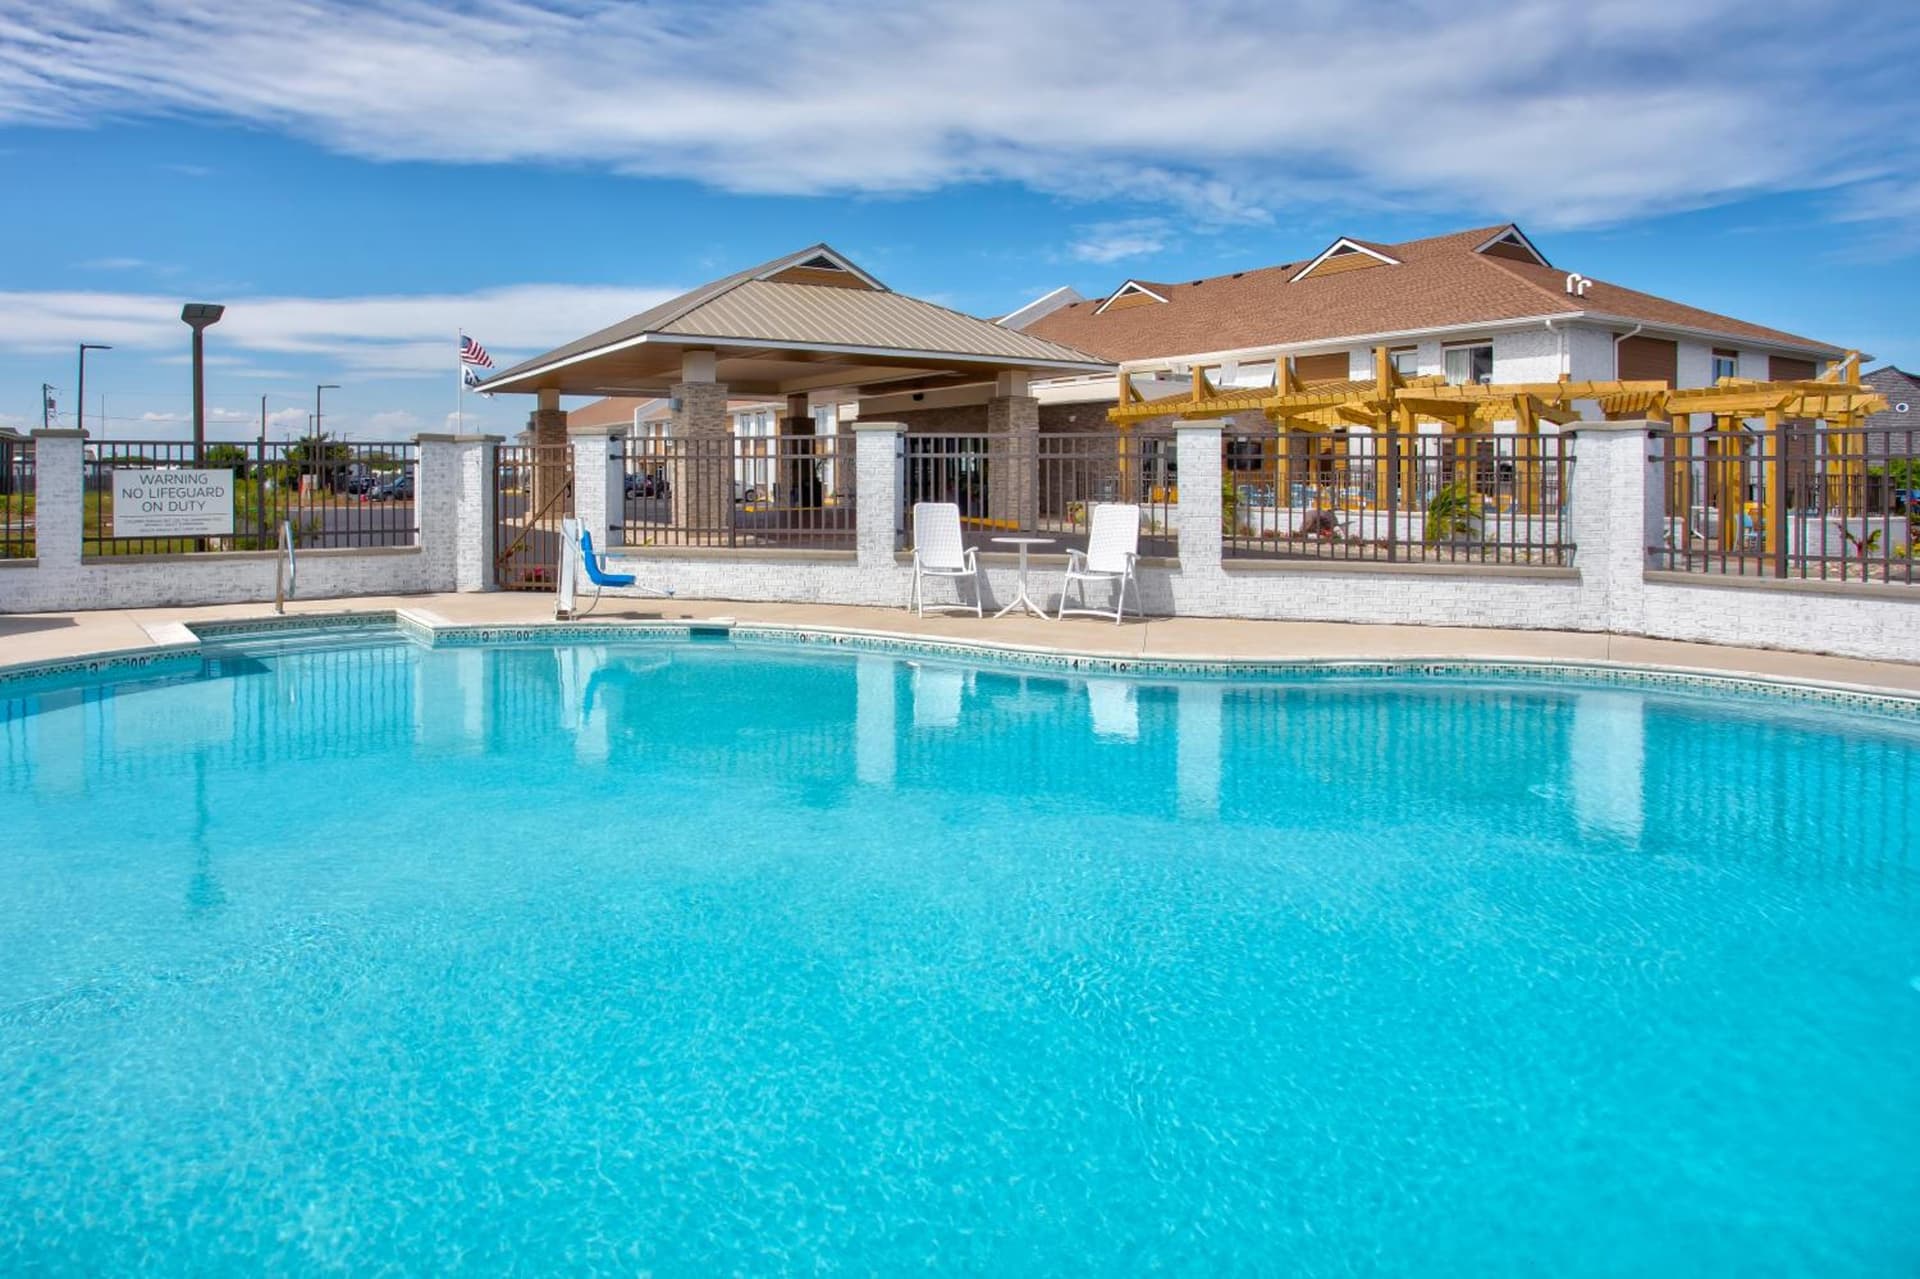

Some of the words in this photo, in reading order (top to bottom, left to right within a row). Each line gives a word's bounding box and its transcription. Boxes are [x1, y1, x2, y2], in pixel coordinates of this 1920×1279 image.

[140, 473, 208, 485] WARNING
[122, 487, 144, 499] NO
[149, 486, 225, 499] LIFEGUARD
[142, 501, 163, 512] ON
[168, 500, 206, 512] DUTY
